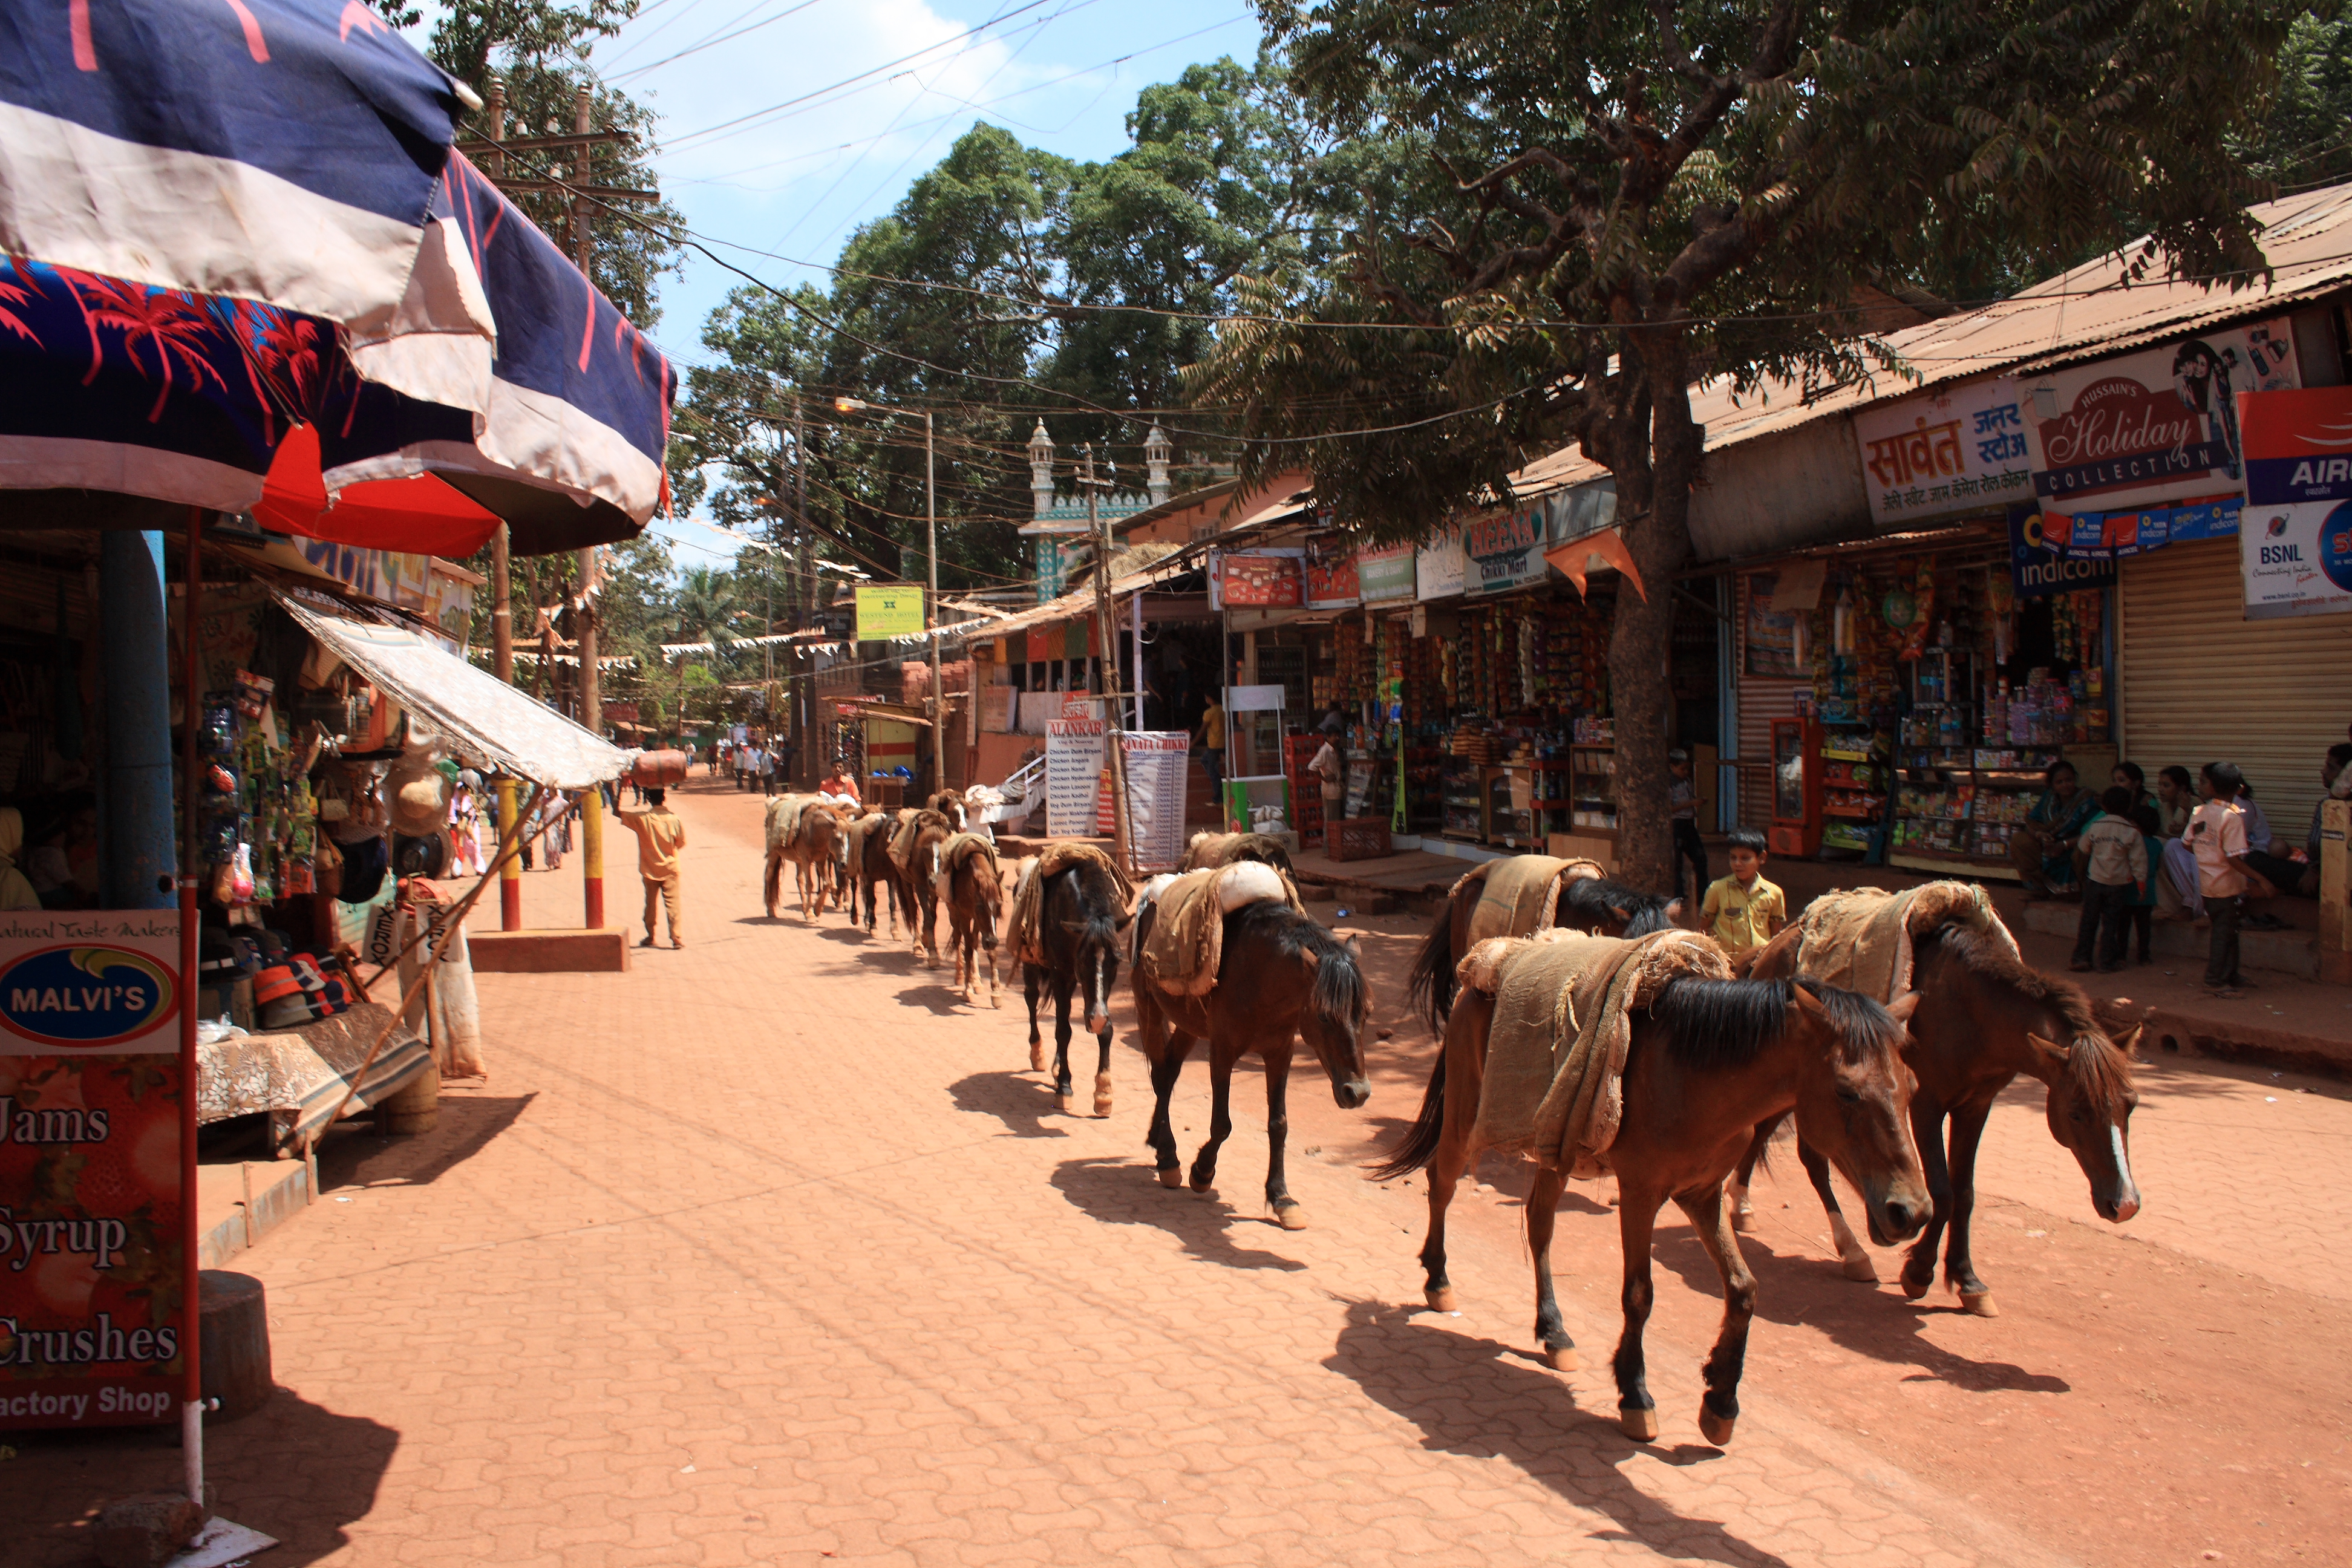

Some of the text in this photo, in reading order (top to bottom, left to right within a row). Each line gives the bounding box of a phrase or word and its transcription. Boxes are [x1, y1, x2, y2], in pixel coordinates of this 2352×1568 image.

[2081, 382, 2137, 408] HUSSAIN'S
[2048, 404, 2192, 463] Holiday
[1866, 417, 1965, 488] सावंत
[2049, 449, 2210, 491] COLLECTION
[2290, 459, 2352, 486] AIR
[1470, 509, 1535, 557] HEENA
[2261, 544, 2303, 564] BSNL
[2022, 553, 2114, 586] indicom
[2253, 567, 2290, 578] Connecting
[1050, 722, 1102, 735] ALANKAR
[1157, 739, 1187, 750] CHIKKI
[0, 920, 54, 938] atural
[370, 907, 394, 967] XEROX
[11, 985, 146, 1012] MALVI'S
[0, 1096, 108, 1143] Jams
[98, 1386, 171, 1417] Shop
